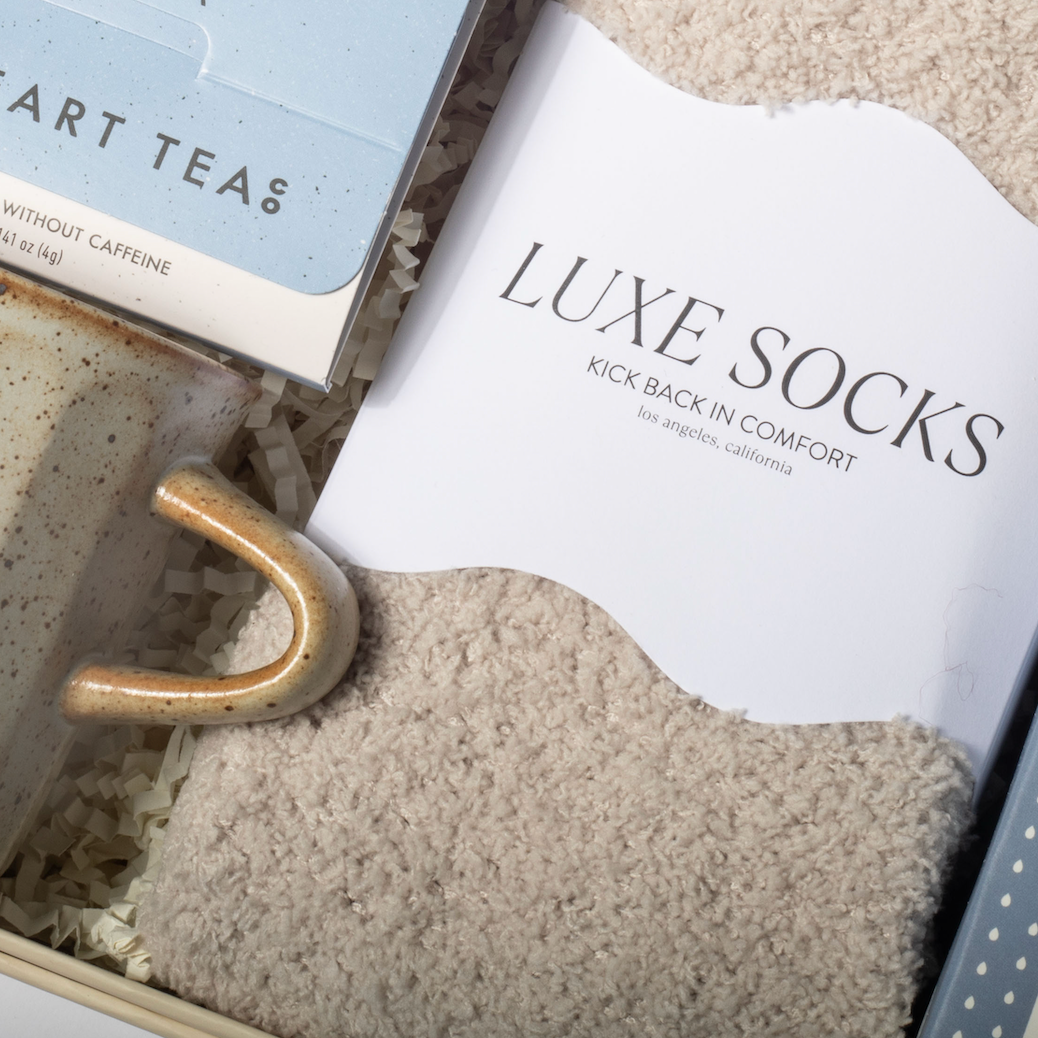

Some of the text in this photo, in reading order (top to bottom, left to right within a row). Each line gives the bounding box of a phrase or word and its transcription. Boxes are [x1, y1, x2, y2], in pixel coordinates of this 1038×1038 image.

[0, 70, 126, 148] ART
[4, 199, 172, 276] WITHOUT CAFFEINE
[20, 240, 35, 254] oz
[37, 242, 63, 266] (4g)
[499, 241, 1005, 477] LUXE SOCKS
[587, 355, 858, 473] KICK BACK IN COMFORT
[637, 404, 793, 476] los angeles, california
